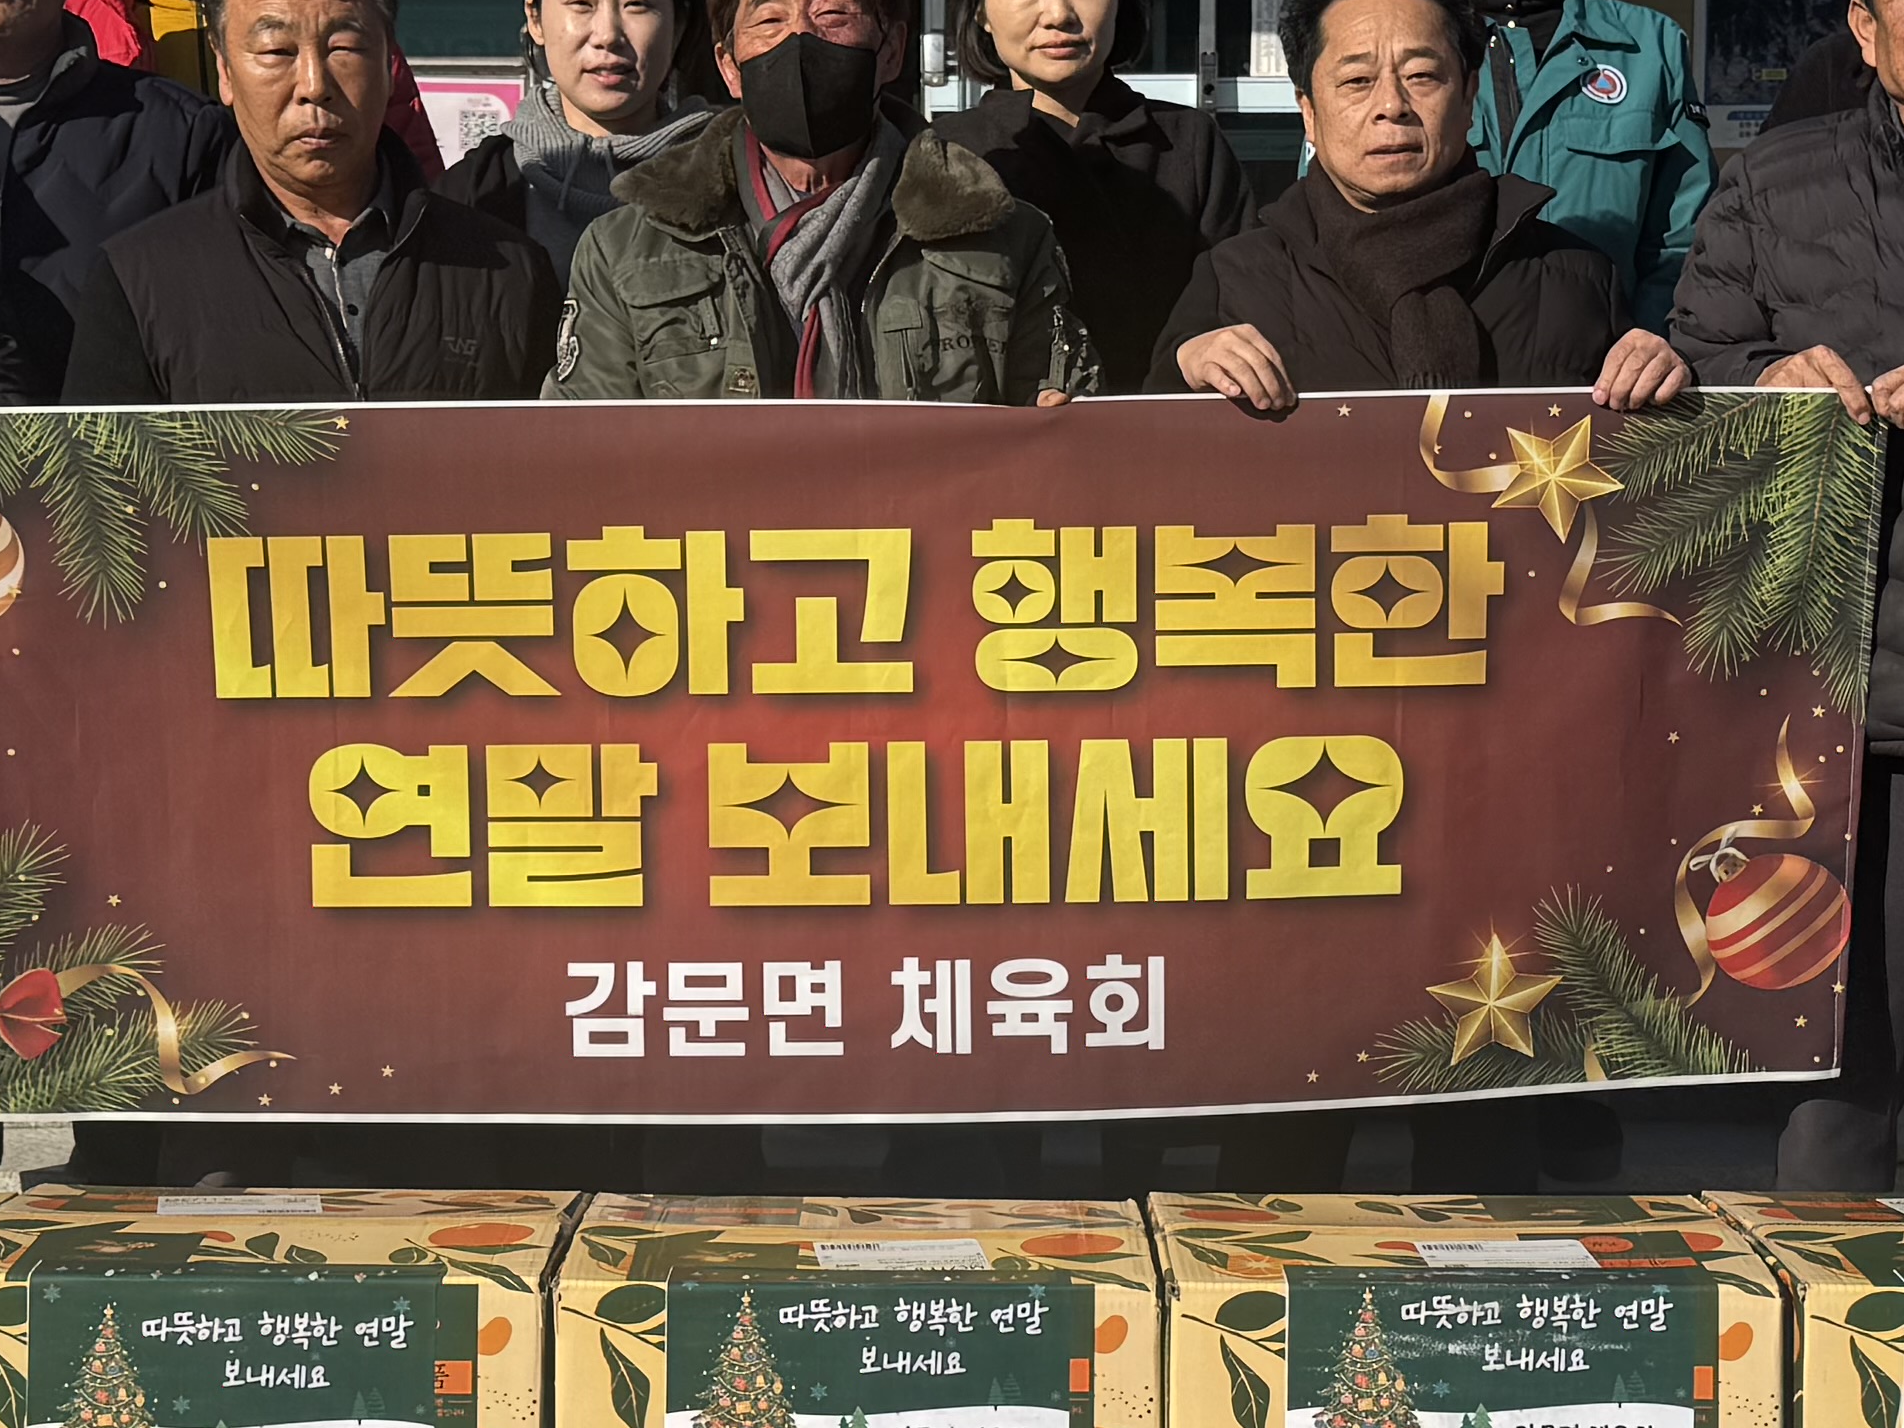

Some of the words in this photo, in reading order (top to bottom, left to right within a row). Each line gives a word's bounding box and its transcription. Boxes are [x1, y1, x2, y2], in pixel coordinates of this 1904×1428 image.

[207, 524, 917, 700] 따뜻하고
[970, 513, 1505, 693] 행복한
[305, 741, 659, 910] 연말
[706, 733, 1405, 909] 보내세요
[562, 956, 846, 1060] 감문면
[888, 951, 1169, 1058] 체육회
[777, 1297, 880, 1334] 따뜻하고
[892, 1297, 979, 1337] 행복한
[989, 1298, 1050, 1336] 연말
[857, 1345, 968, 1377] 보내세요
